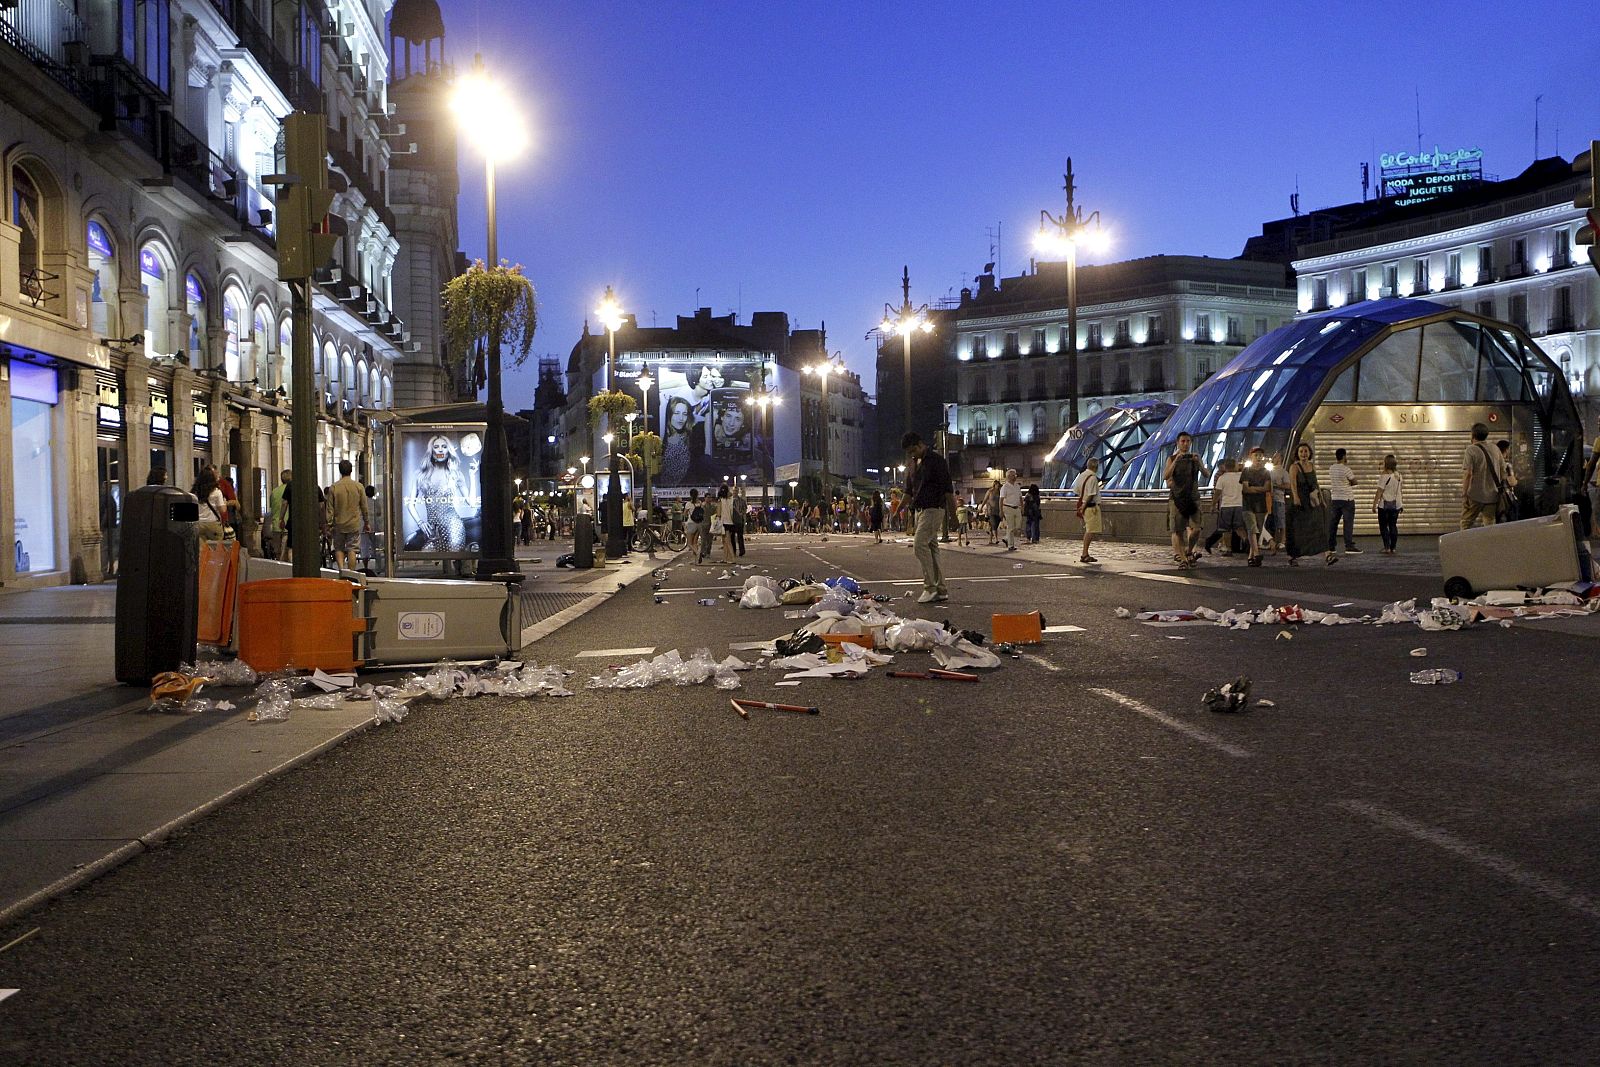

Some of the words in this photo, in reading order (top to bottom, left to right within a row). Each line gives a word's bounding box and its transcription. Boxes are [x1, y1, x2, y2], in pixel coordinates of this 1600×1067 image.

[1387, 179, 1414, 187] MODA
[1426, 174, 1472, 184] DEPORTES
[1410, 185, 1453, 197] JUGUETES
[1400, 413, 1430, 424] SOL
[1070, 429, 1083, 440] NO
